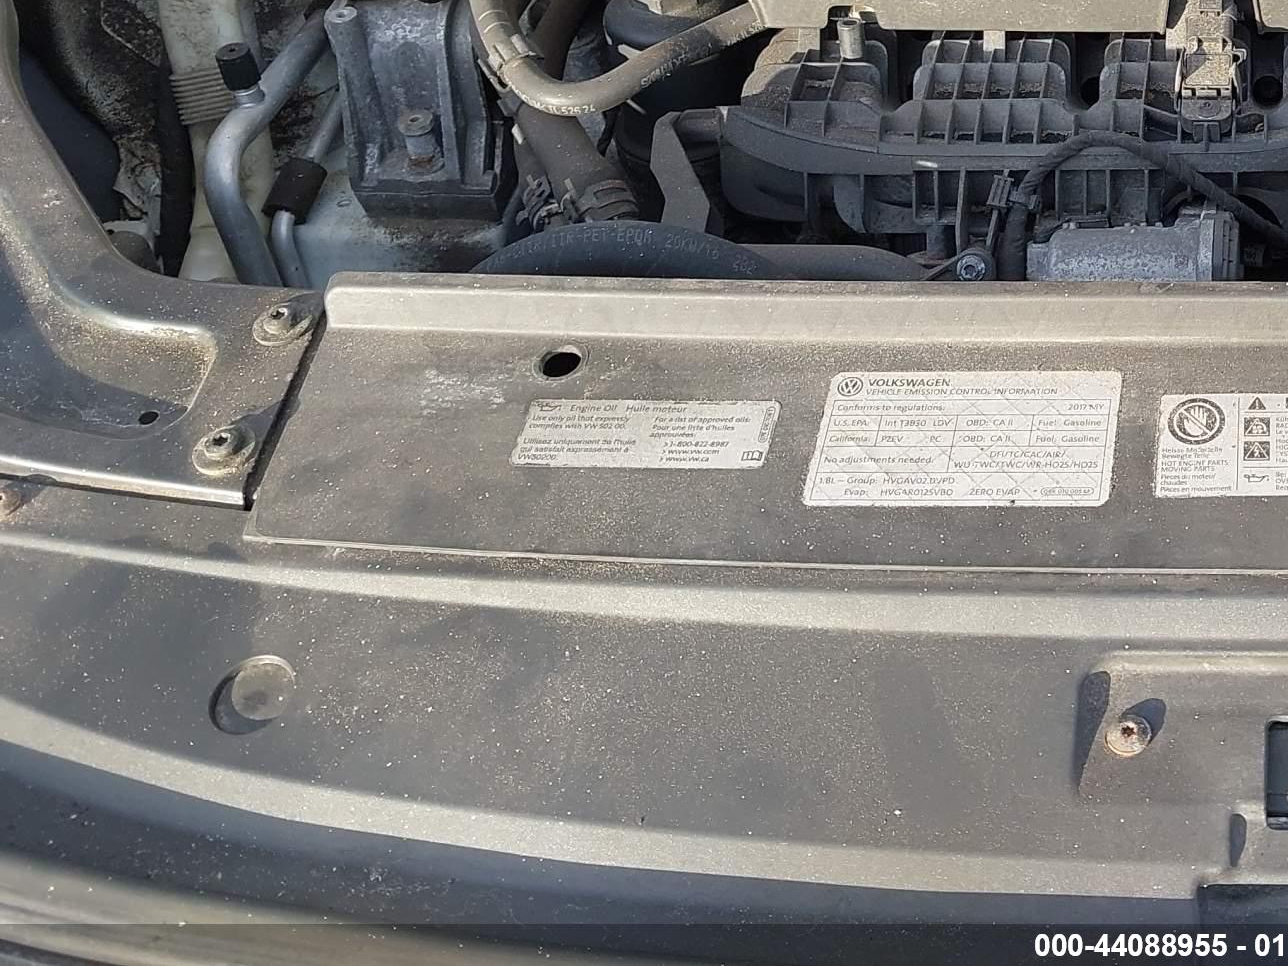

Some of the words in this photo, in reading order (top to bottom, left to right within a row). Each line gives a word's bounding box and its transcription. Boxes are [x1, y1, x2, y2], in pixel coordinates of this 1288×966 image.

[868, 378, 951, 387] VOLKSWAGEN
[570, 405, 601, 413] Engine
[603, 405, 618, 413] Oil
[625, 405, 651, 413] Huile
[652, 405, 688, 413] moteur
[837, 404, 880, 412] Conforms
[881, 404, 891, 412] to
[932, 419, 951, 427] LDV
[966, 419, 989, 427] OBD:
[993, 419, 1007, 427] CA
[1063, 419, 1101, 427] Gasoline
[881, 435, 904, 443] PZEV
[990, 435, 1003, 443] CA
[1061, 435, 1100, 443] Gasoline
[824, 456, 836, 464] No
[838, 456, 896, 464] adjustments
[969, 488, 993, 497] ZERO
[995, 488, 1021, 497] EVAP
